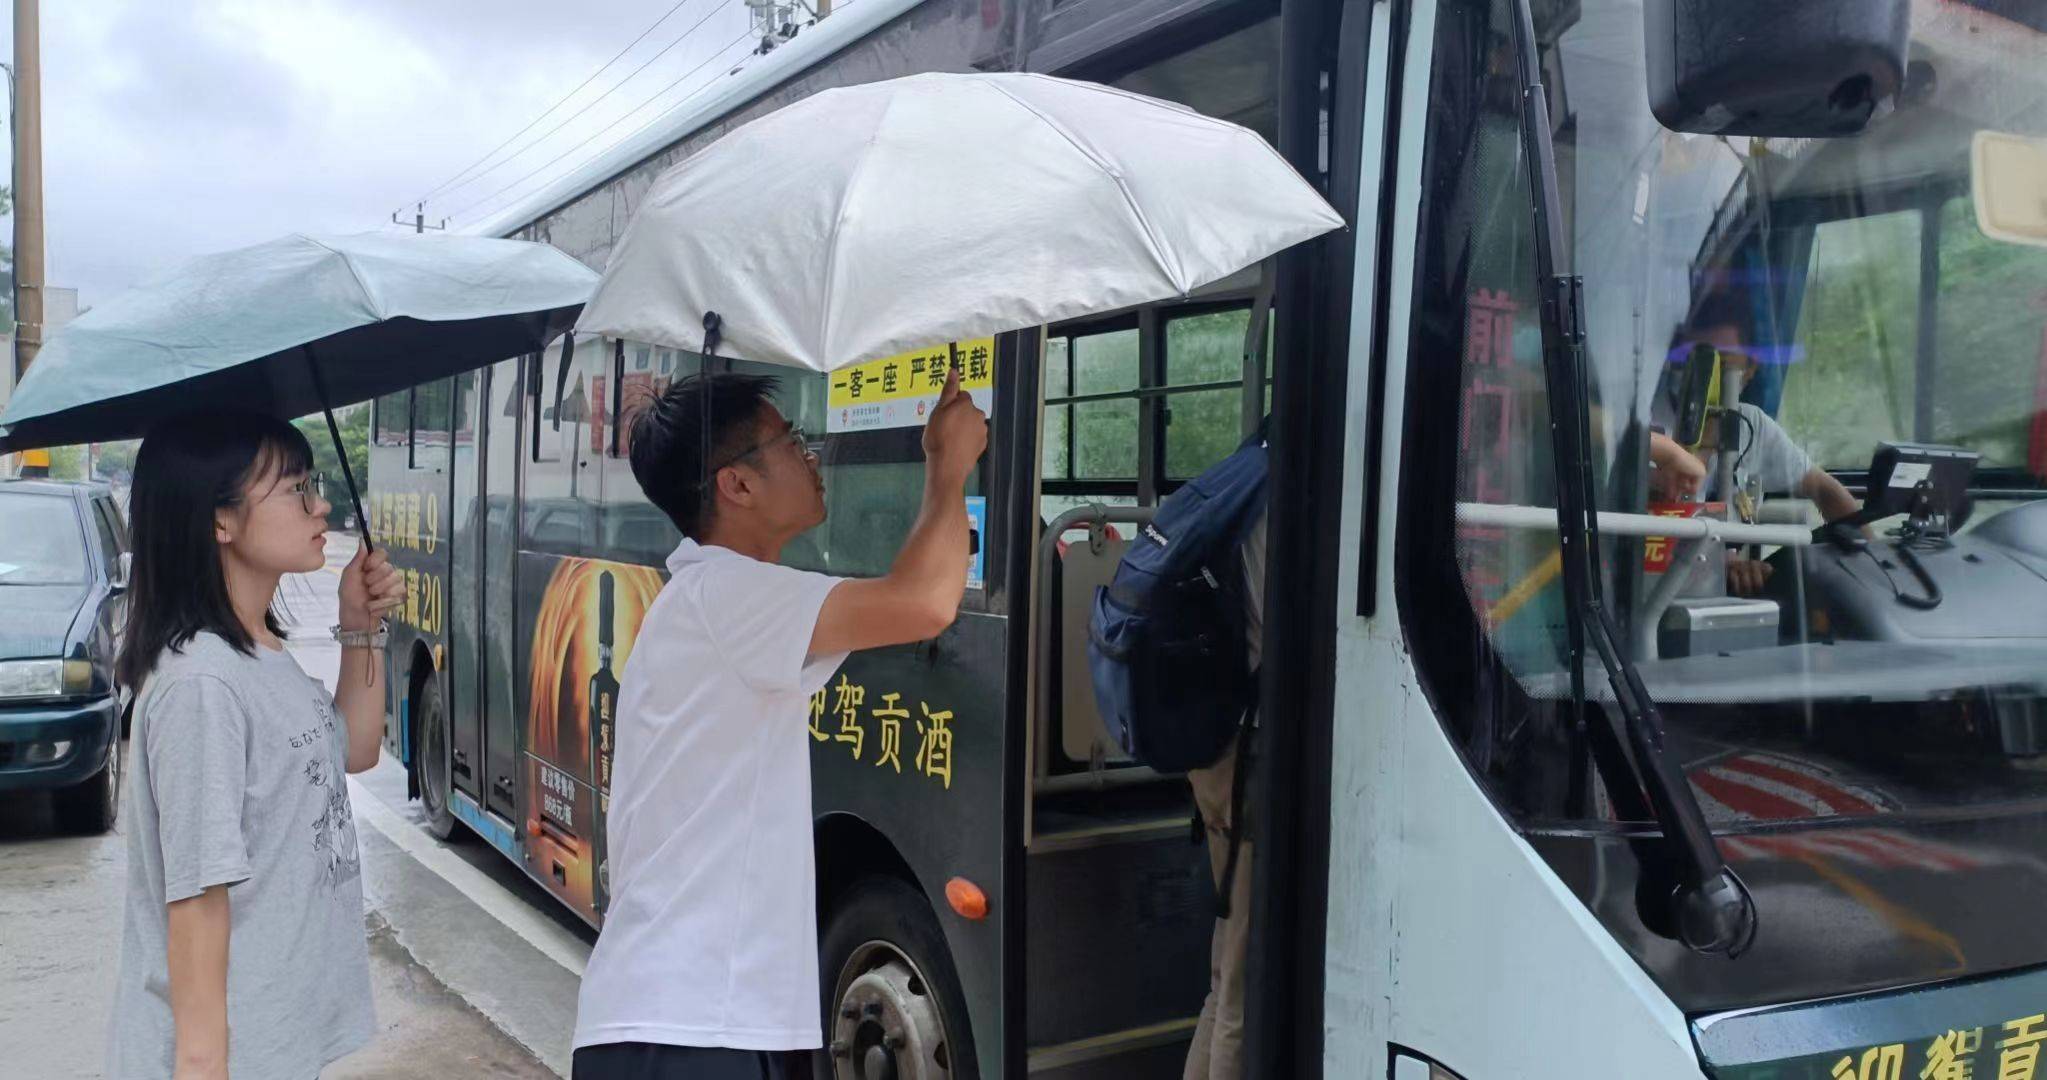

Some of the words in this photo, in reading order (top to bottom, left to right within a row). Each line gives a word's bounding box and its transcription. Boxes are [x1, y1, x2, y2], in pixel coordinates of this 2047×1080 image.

[834, 363, 898, 398] 一客一座
[426, 493, 438, 554] 9
[422, 571, 442, 636] 20
